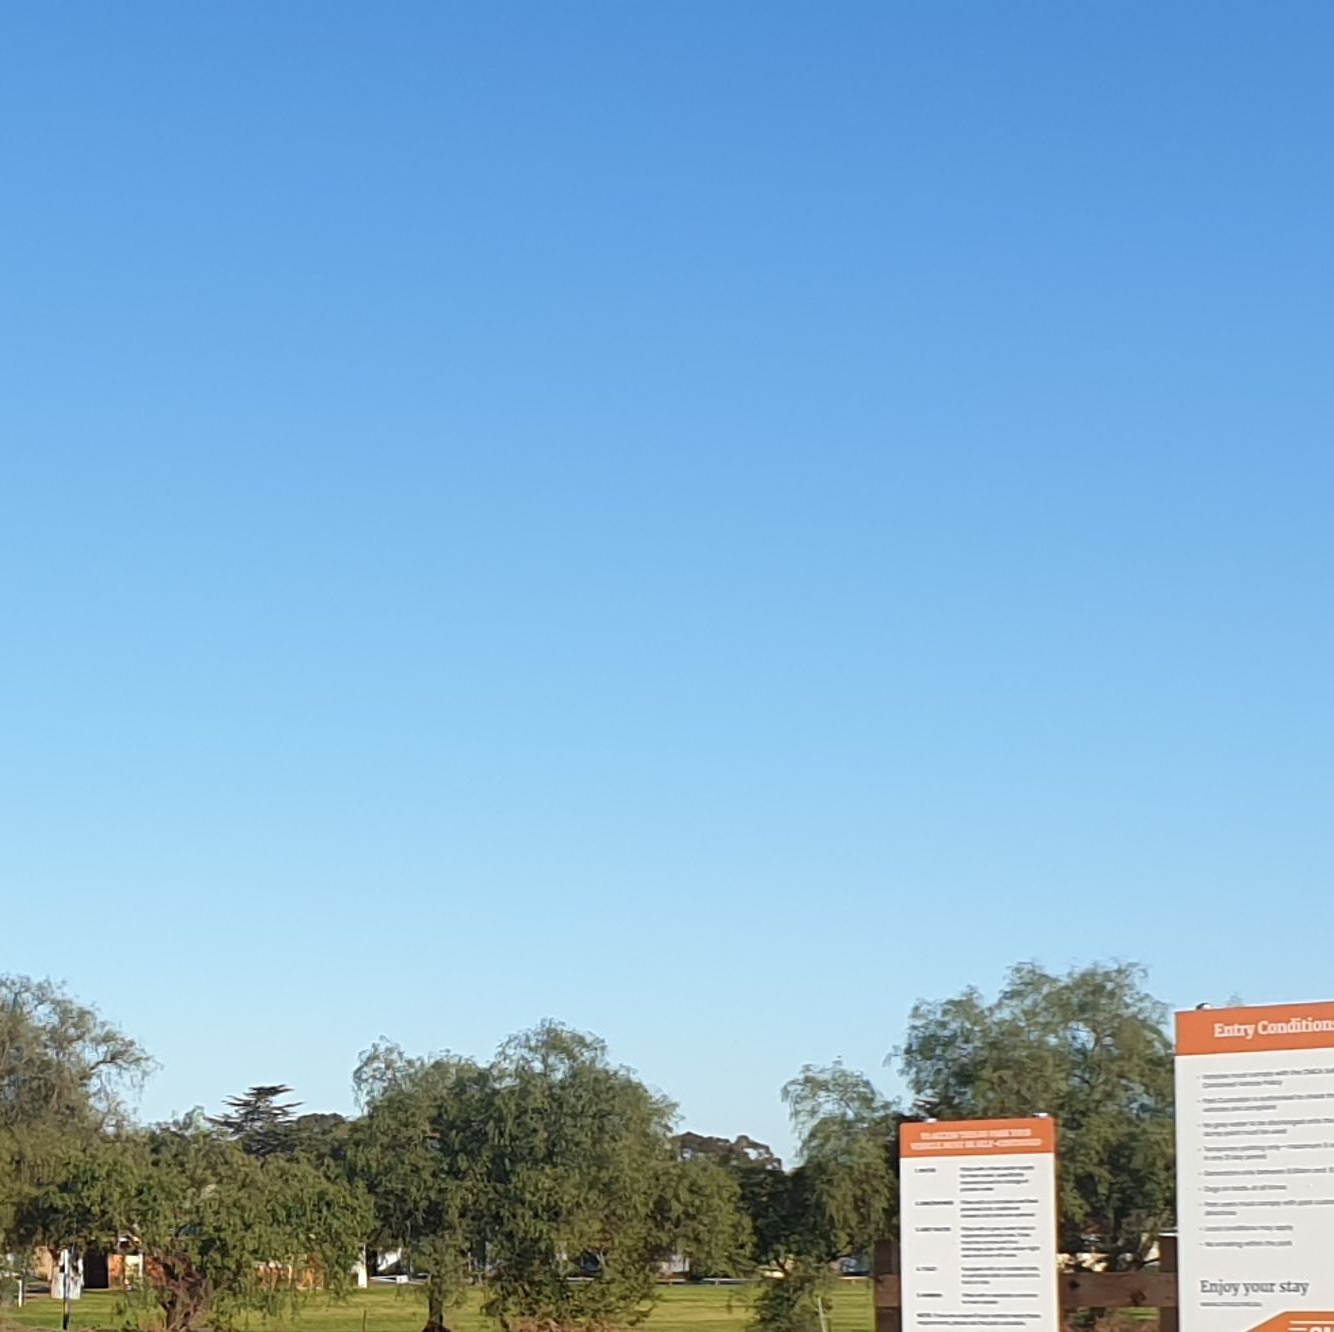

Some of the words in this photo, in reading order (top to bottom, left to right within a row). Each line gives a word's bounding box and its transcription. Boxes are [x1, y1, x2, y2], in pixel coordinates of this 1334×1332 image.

[1213, 1022, 1255, 1040] Entry
[1200, 1279, 1240, 1296] Enjoy
[1242, 1282, 1276, 1296] your
[1279, 1280, 1310, 1296] stay
